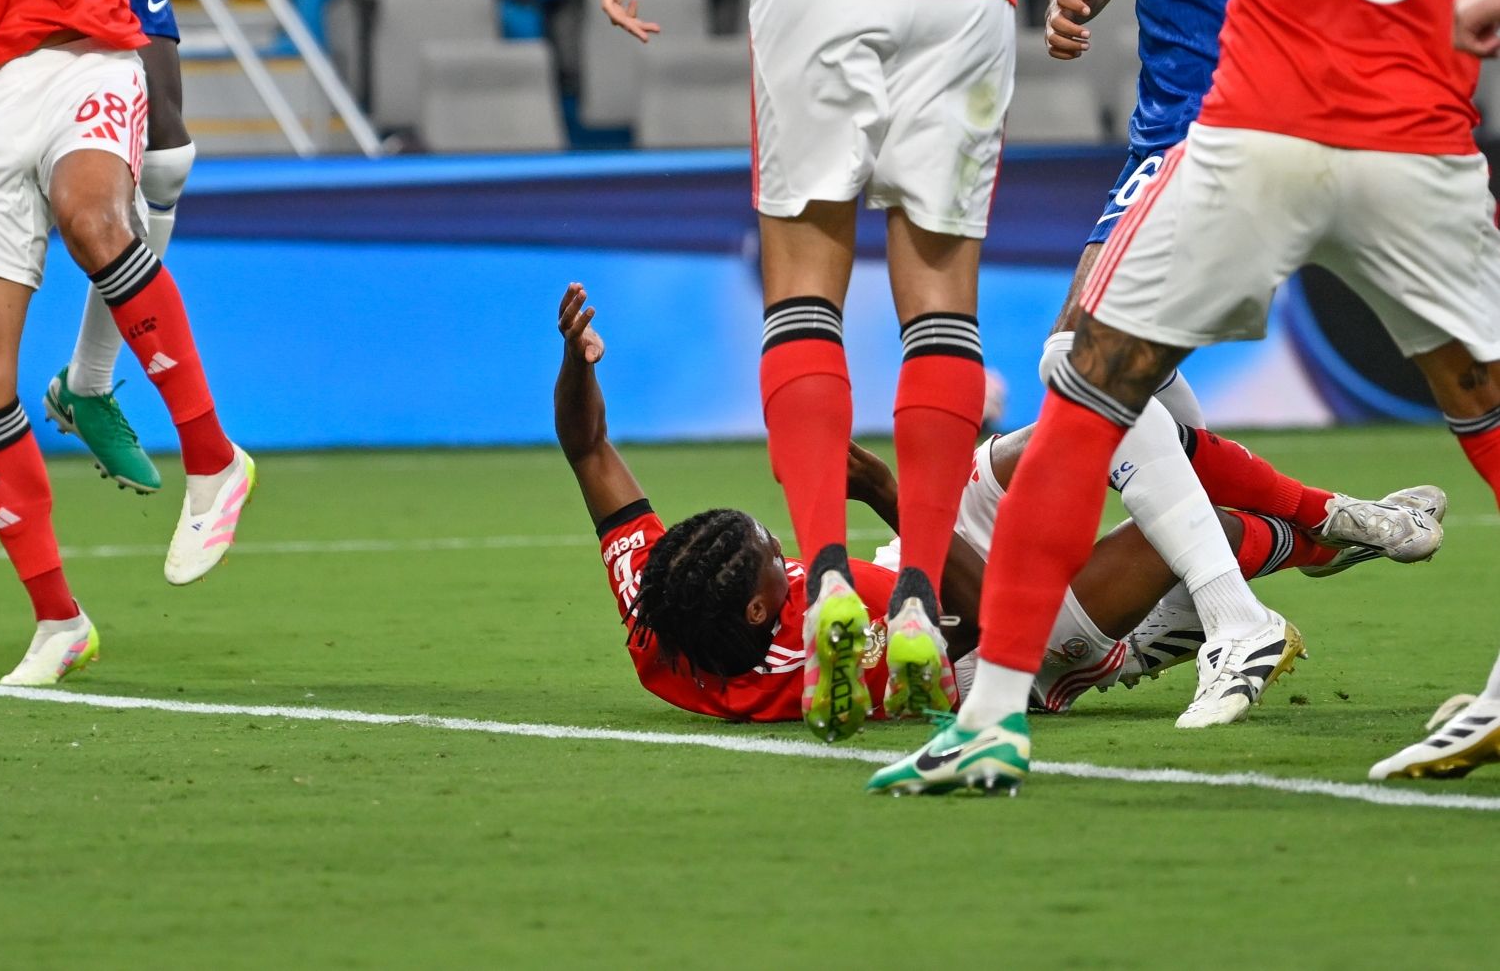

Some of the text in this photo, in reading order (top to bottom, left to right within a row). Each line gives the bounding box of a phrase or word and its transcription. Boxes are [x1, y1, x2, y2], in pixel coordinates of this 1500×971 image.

[74, 91, 127, 128] 68
[1115, 155, 1164, 207] 6
[1107, 461, 1134, 484] FC
